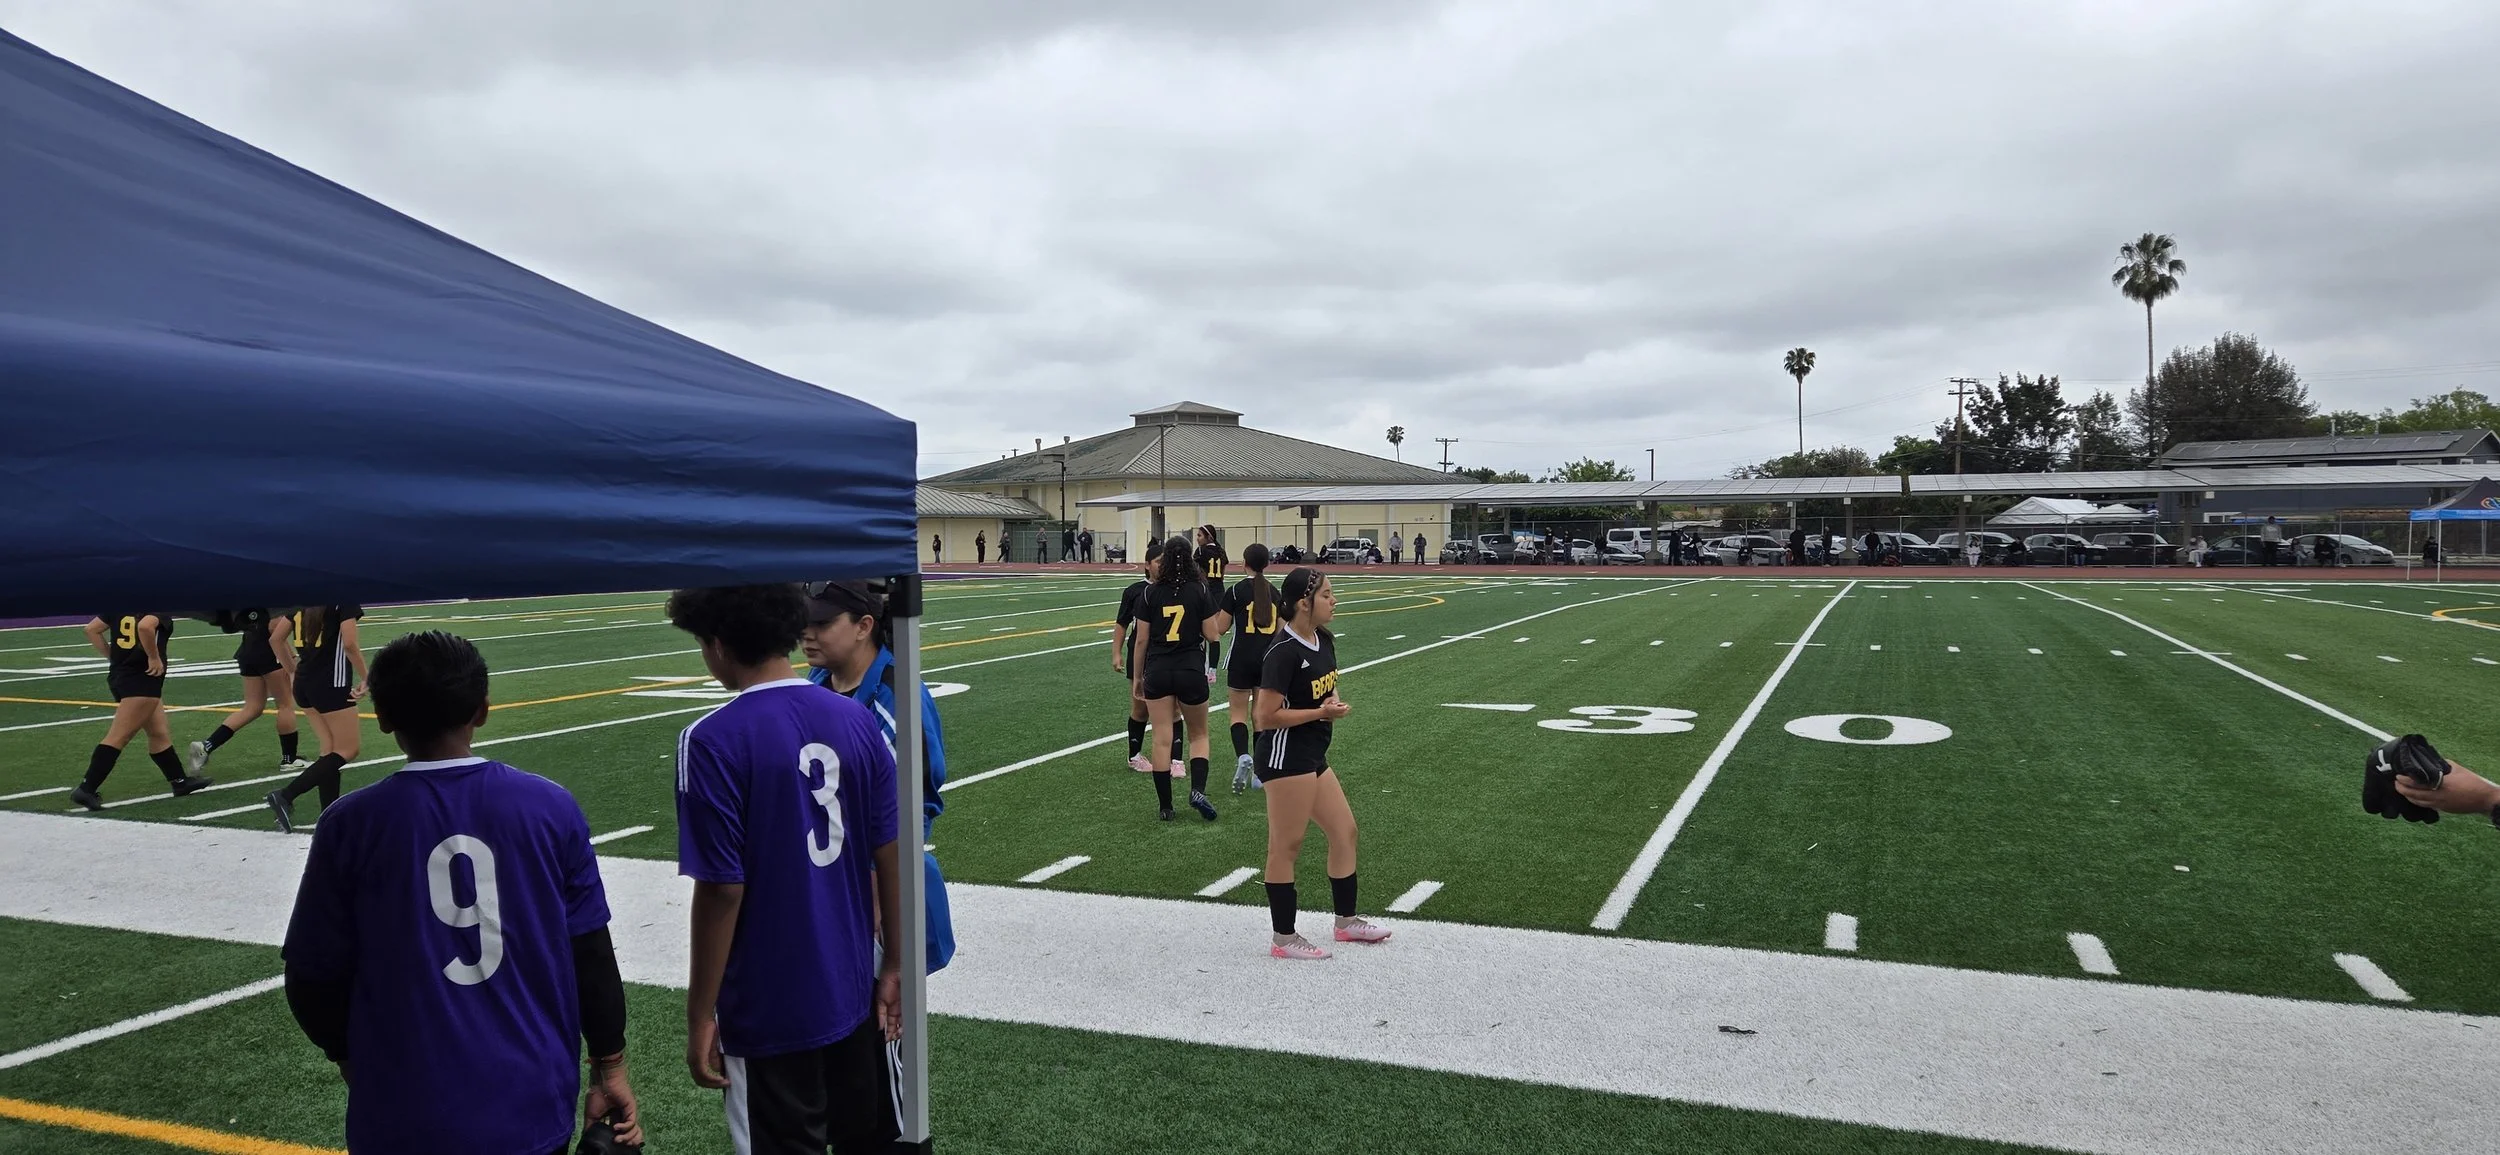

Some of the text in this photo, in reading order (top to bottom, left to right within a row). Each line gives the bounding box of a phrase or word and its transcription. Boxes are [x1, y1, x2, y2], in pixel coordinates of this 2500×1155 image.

[1208, 558, 1223, 579] 11
[117, 616, 137, 650] 9
[1162, 605, 1185, 642] 7
[798, 742, 845, 867] 3
[427, 834, 504, 986] 9
